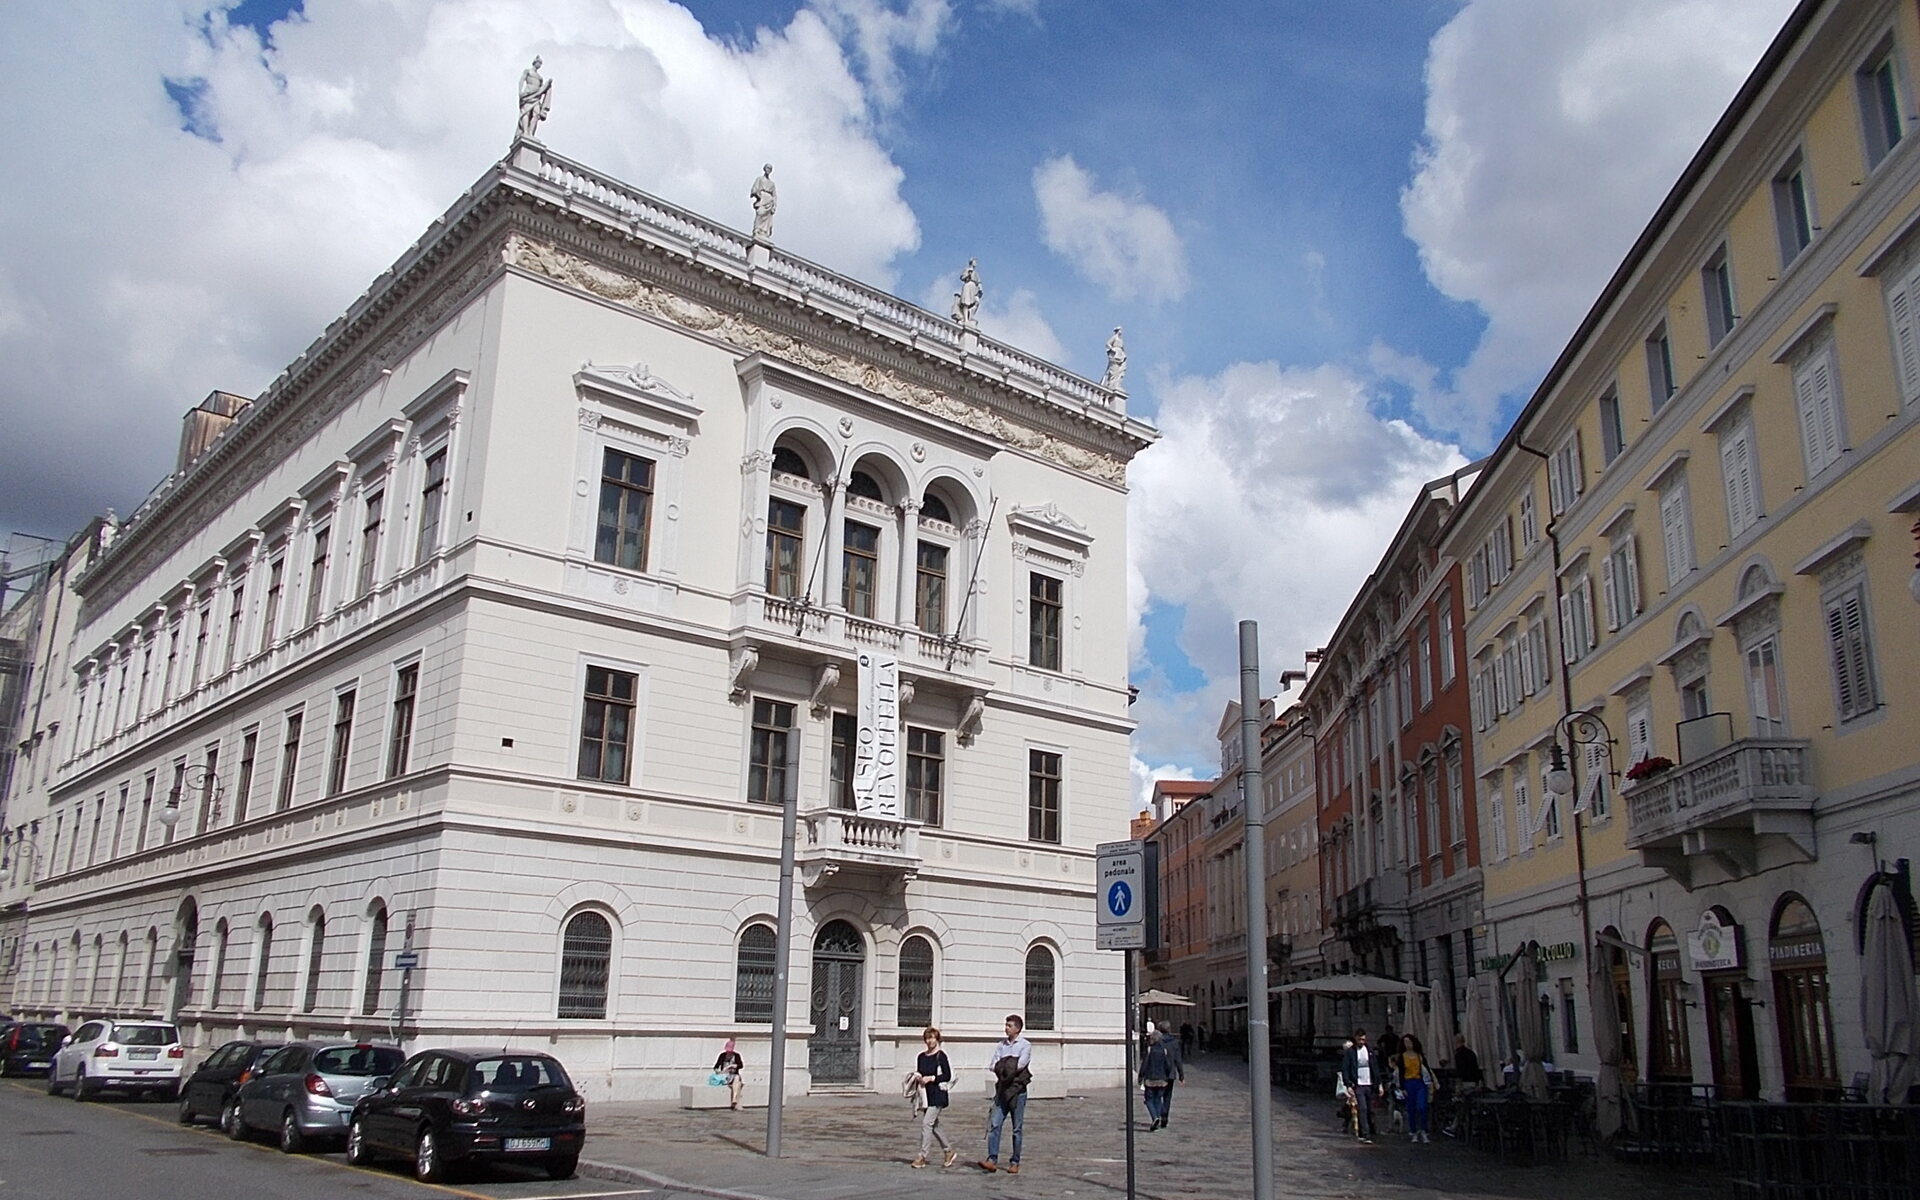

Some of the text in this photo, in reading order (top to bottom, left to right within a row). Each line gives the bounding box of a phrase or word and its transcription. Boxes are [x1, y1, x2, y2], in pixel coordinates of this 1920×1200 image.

[877, 662, 896, 816] REVOLTELLA
[857, 727, 876, 812] MUSEO
[1104, 866, 1135, 879] pedonale
[1769, 942, 1823, 960] PIADINERIA
